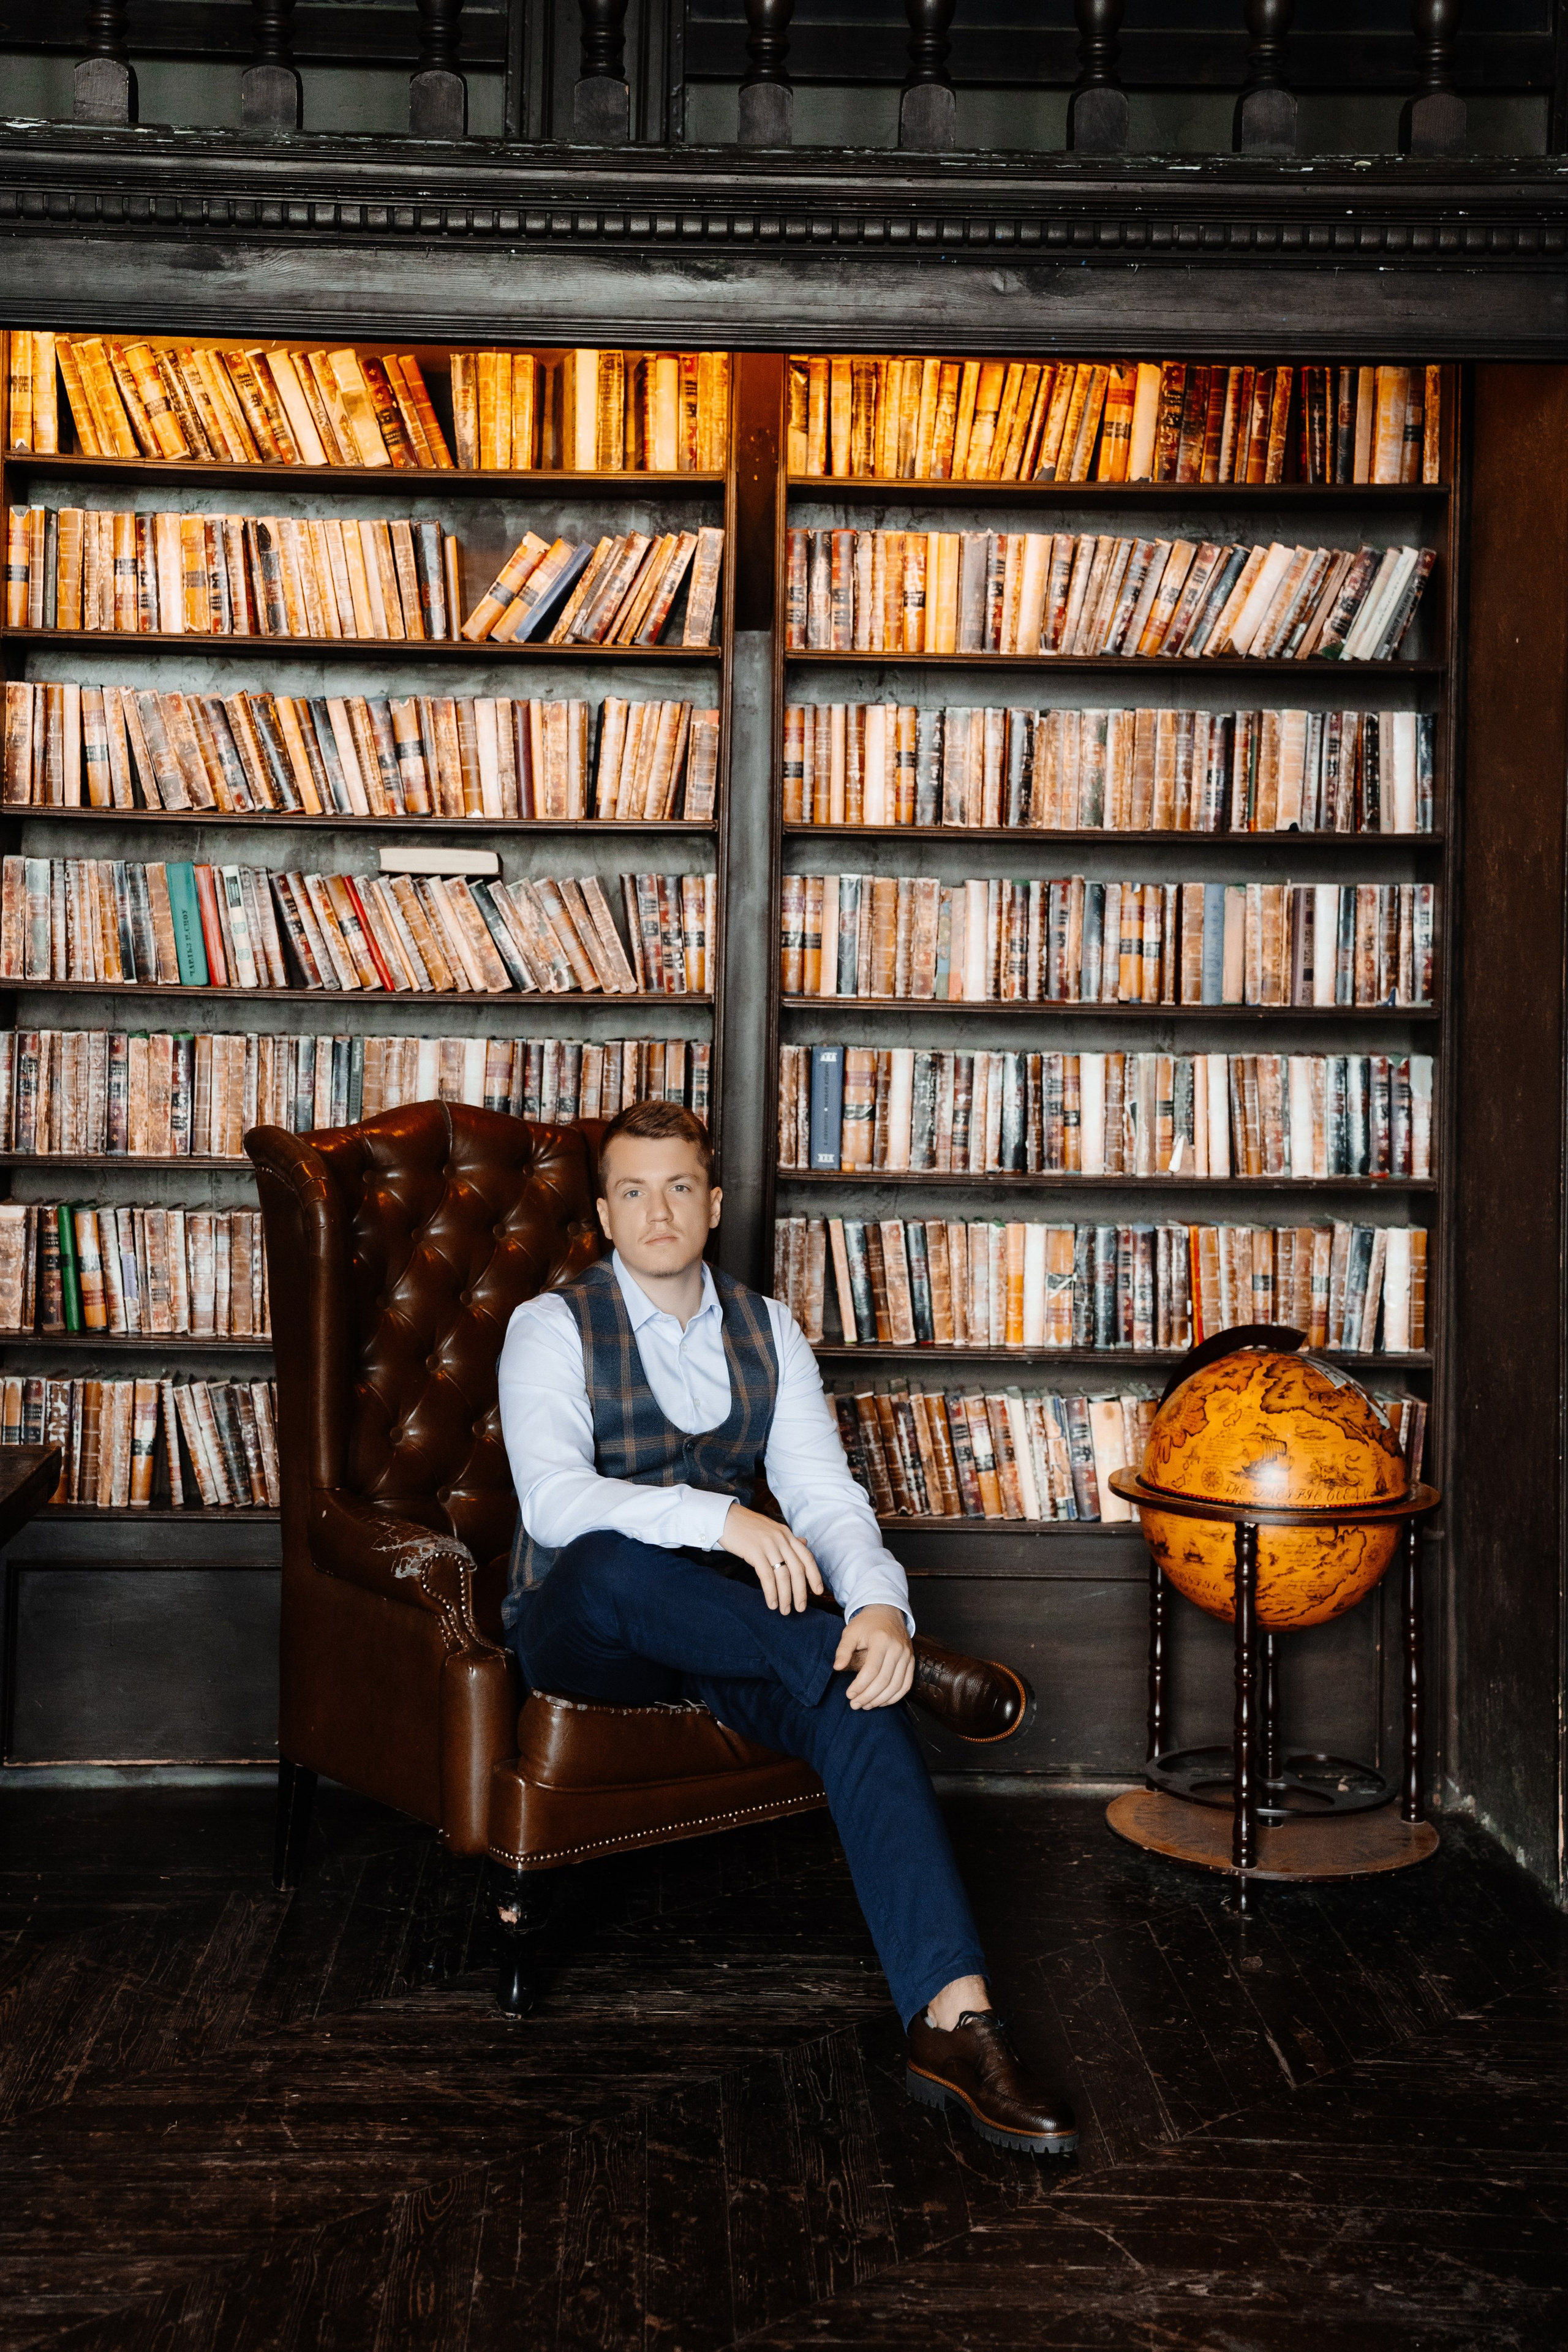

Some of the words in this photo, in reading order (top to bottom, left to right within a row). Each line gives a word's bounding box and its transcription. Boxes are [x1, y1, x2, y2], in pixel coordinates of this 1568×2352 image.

[186, 943, 195, 977] ЧАРЛЬЗ
[1224, 1481, 1246, 1495] THE
[1253, 1485, 1322, 1501] PACIFIC
[1327, 1487, 1371, 1501] OCEAN
